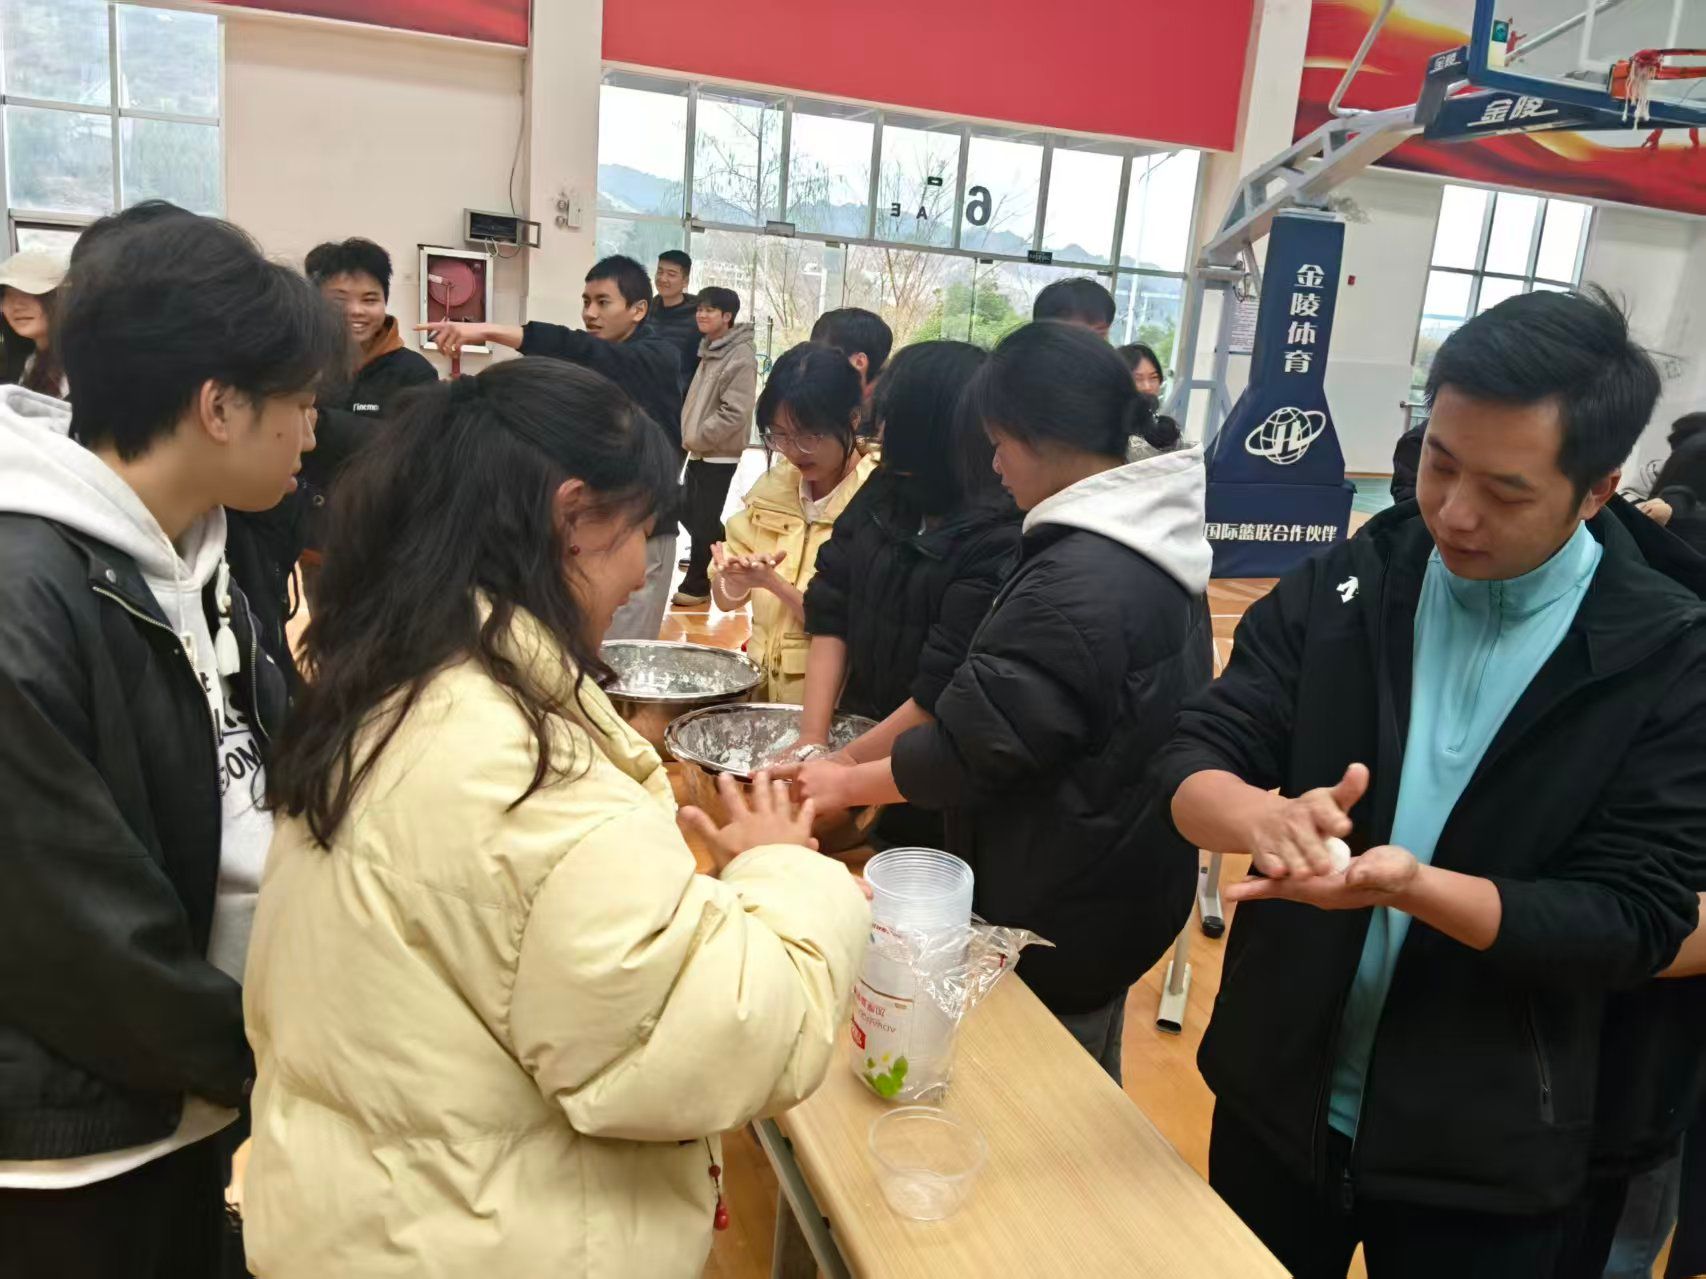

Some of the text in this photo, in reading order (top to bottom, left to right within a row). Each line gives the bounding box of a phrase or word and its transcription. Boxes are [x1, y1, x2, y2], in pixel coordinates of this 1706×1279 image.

[1468, 96, 1557, 125] 金陵
[1284, 263, 1325, 373] 金陵体育
[1204, 522, 1337, 542] 国际篮联合作伙伴
